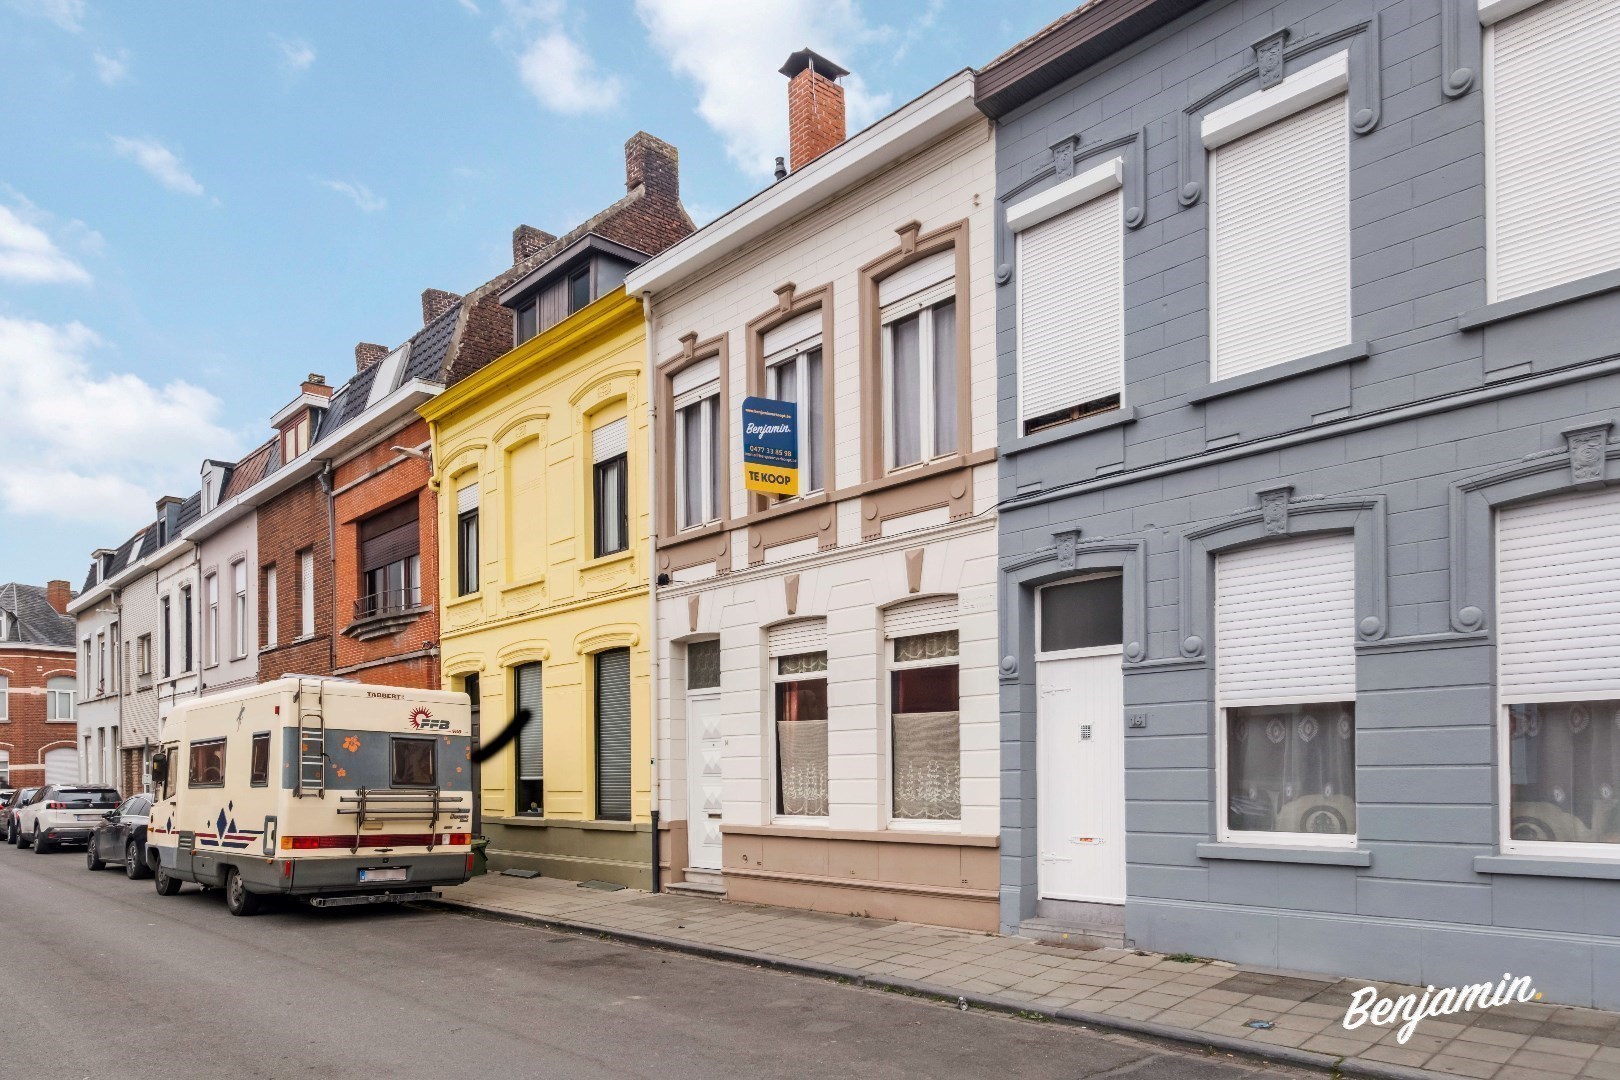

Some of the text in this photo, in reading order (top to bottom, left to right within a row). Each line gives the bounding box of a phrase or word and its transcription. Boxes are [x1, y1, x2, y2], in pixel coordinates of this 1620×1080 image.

[749, 445, 764, 453] 0477
[749, 471, 791, 485] TE KOOP
[420, 718, 450, 730] FFB
